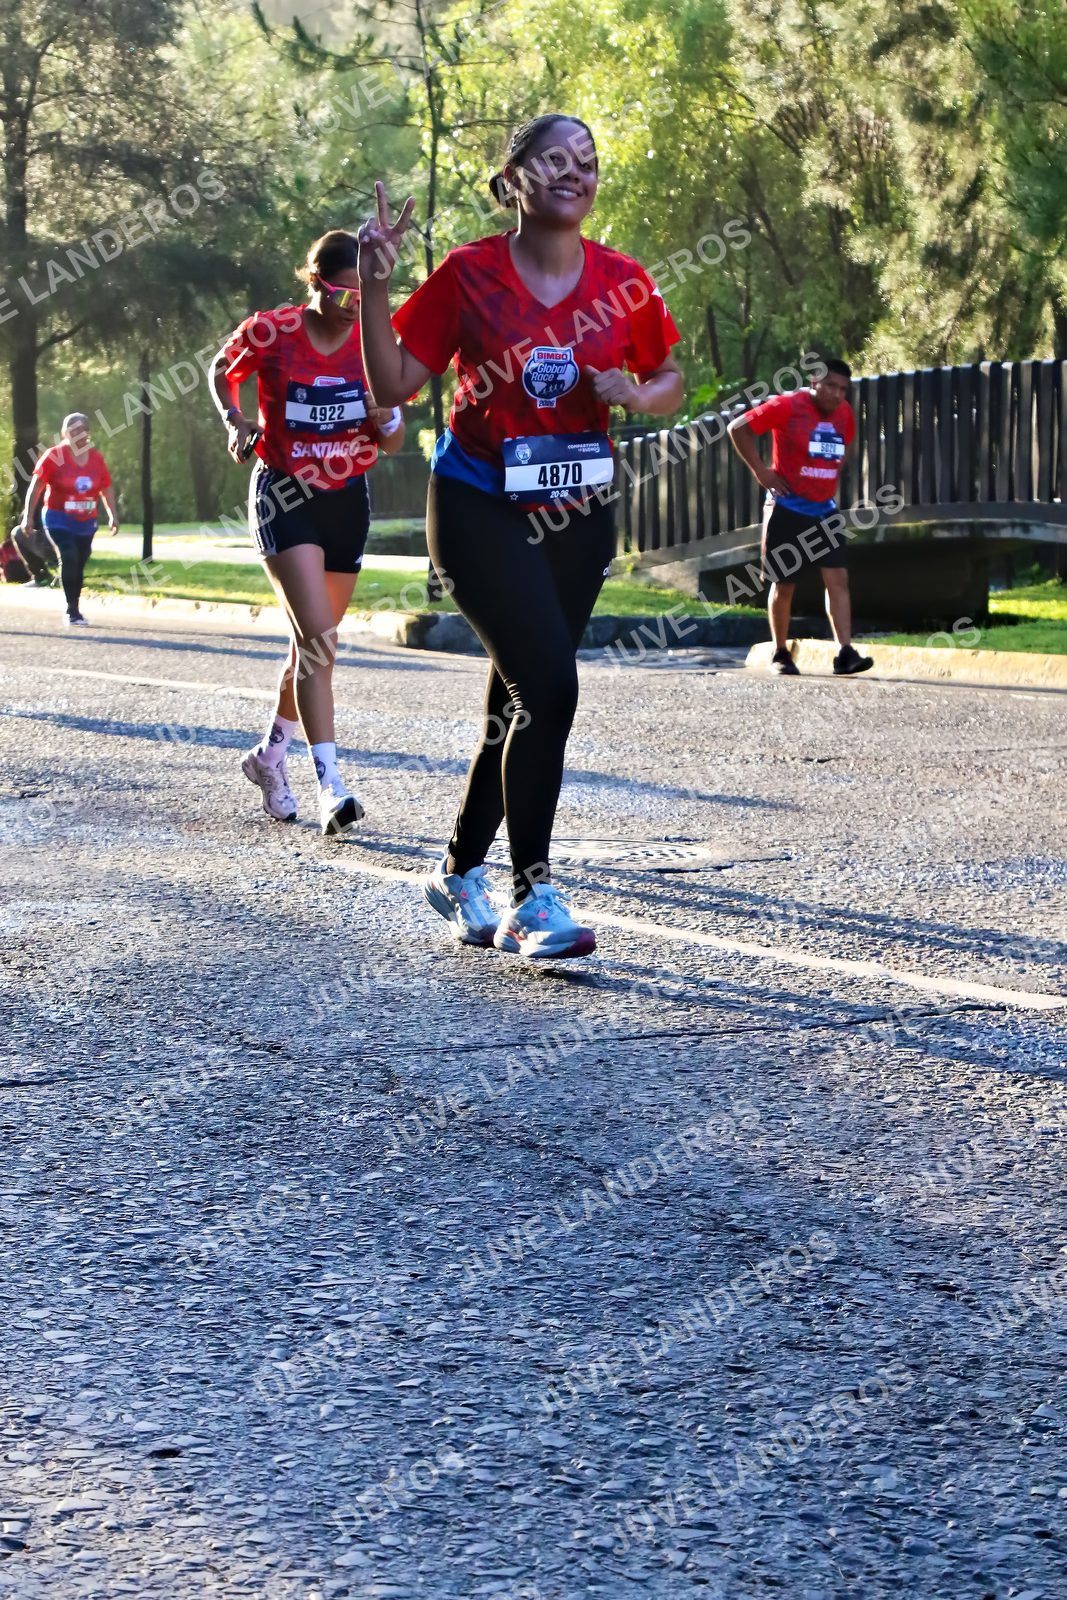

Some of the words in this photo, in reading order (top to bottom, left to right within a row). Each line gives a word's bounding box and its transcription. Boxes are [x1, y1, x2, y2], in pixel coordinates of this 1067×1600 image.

[537, 352, 568, 360] BIMBO
[531, 371, 555, 381] Race
[537, 363, 566, 375] Global
[309, 405, 345, 422] 4922
[291, 441, 361, 459] SANTIAGO
[538, 462, 583, 487] 4870
